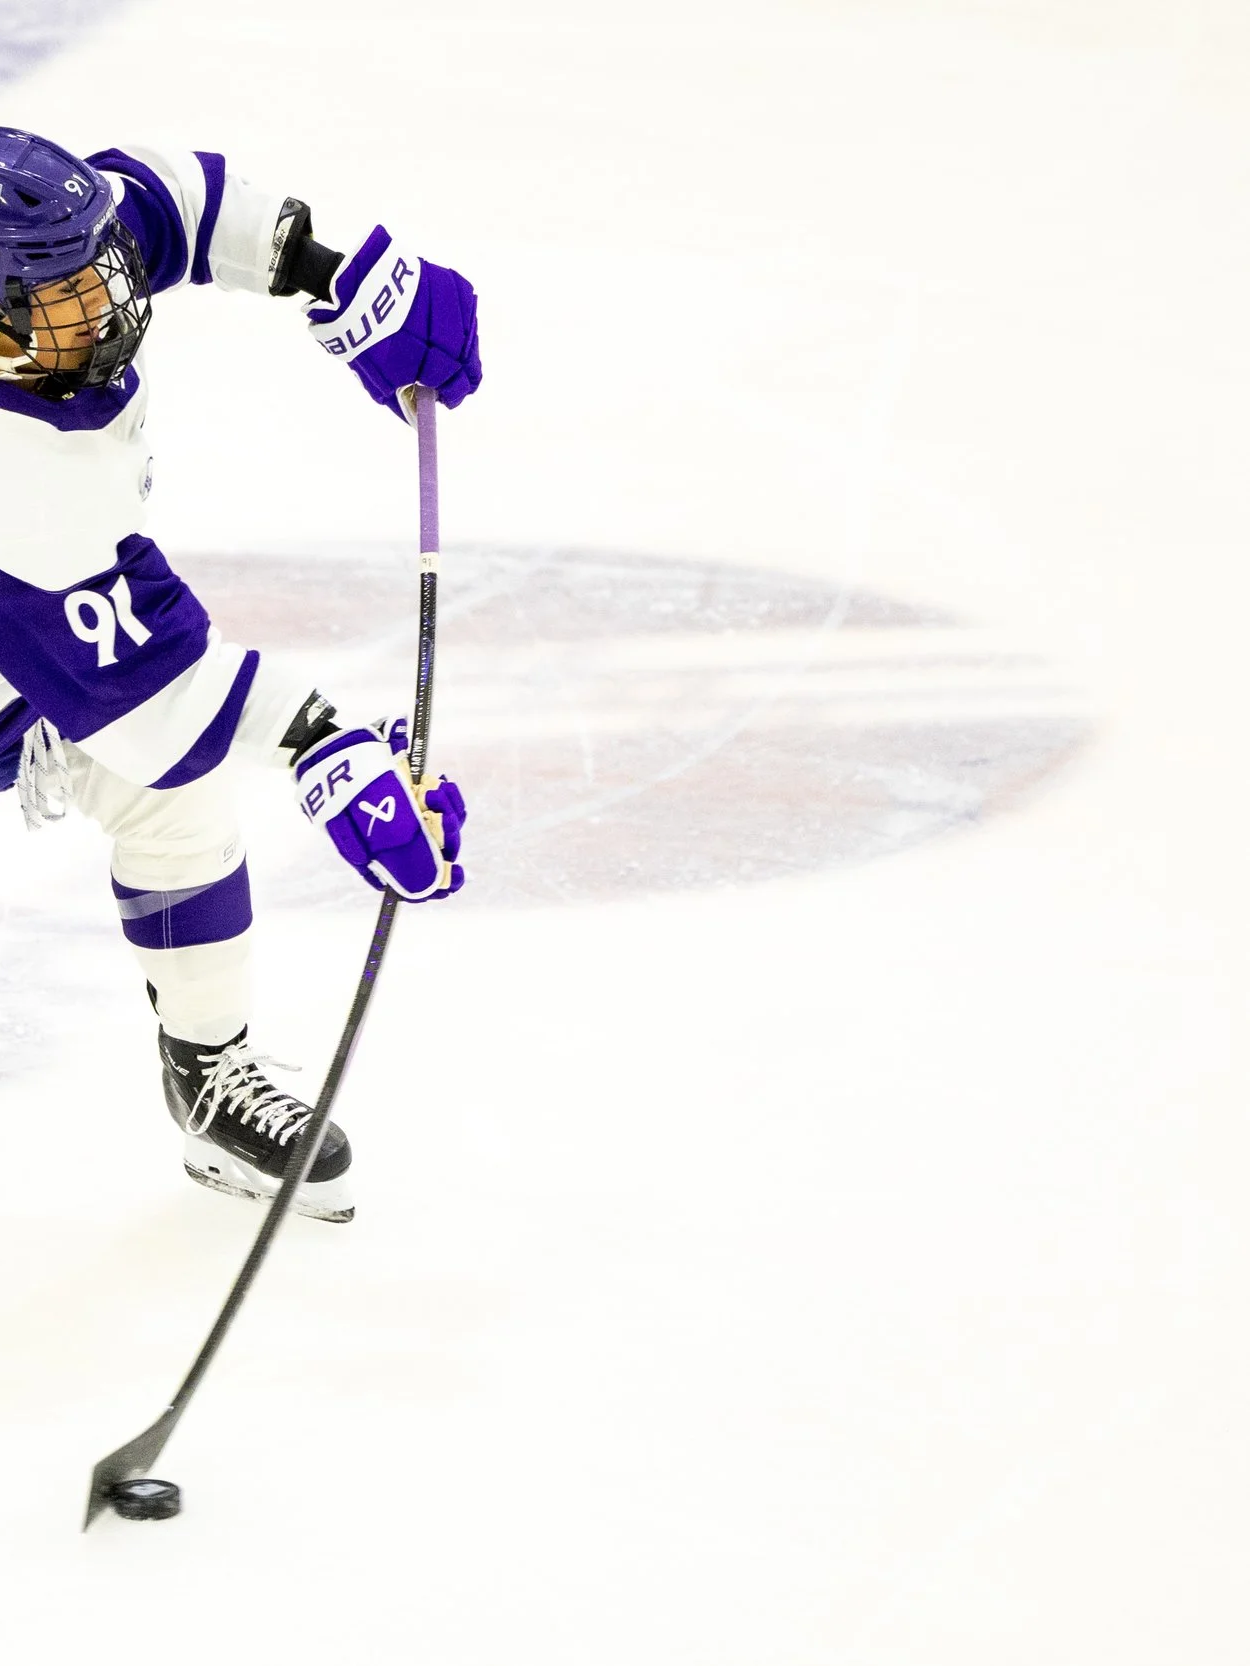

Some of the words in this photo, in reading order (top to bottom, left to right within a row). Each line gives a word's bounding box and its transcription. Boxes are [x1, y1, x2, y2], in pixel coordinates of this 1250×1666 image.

[64, 174, 89, 197] 91
[318, 257, 414, 356] AUER
[63, 574, 153, 668] 91
